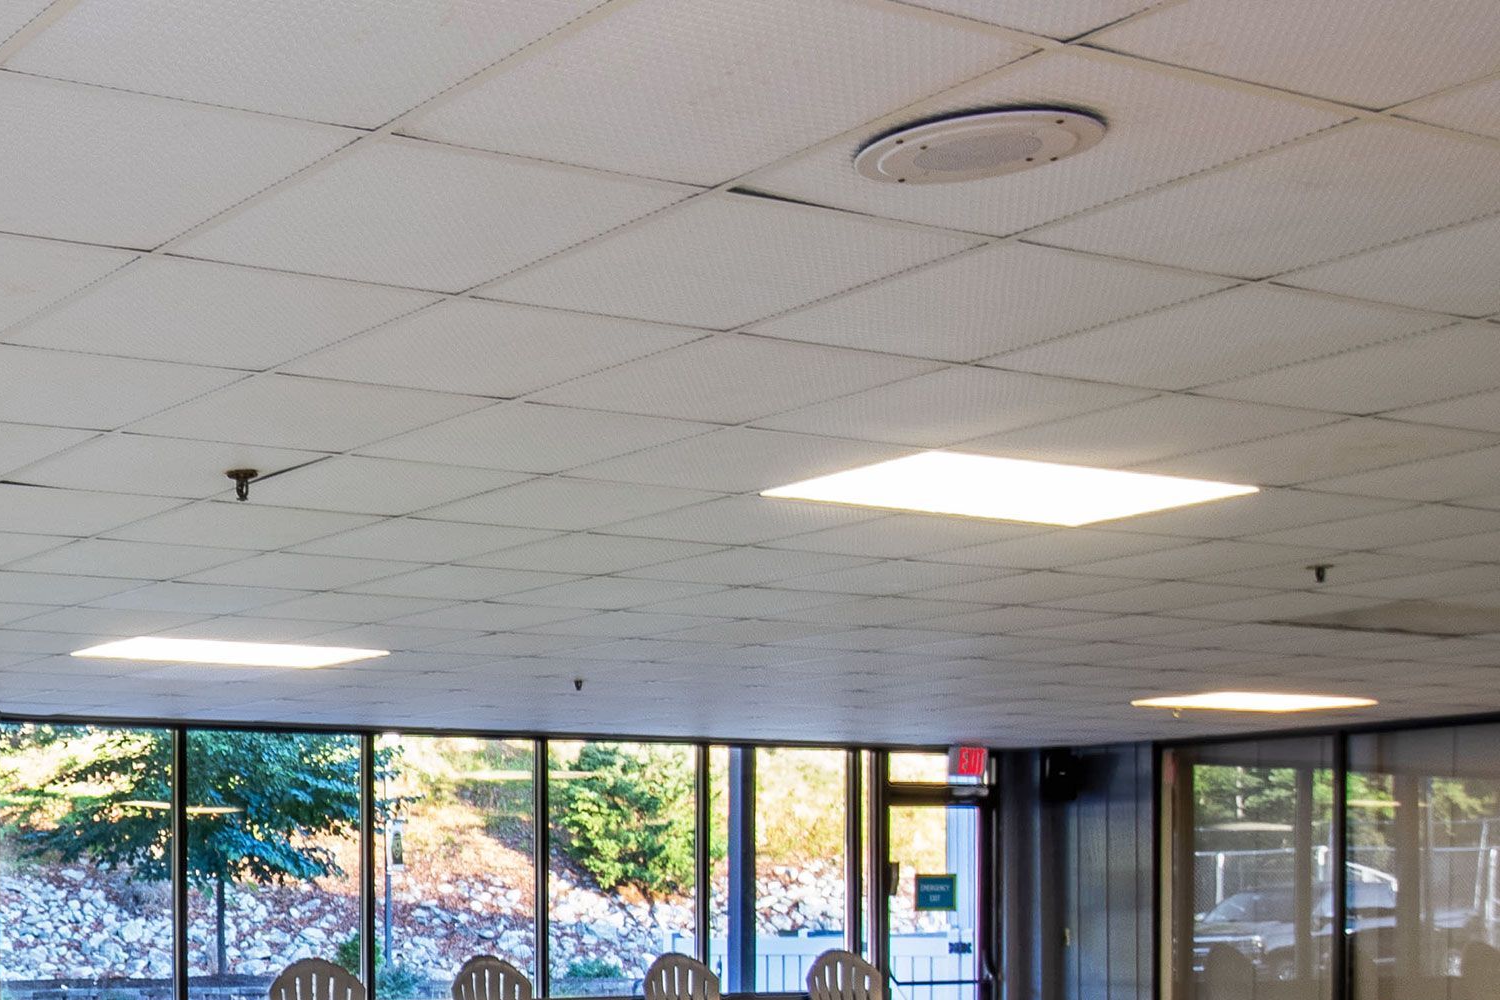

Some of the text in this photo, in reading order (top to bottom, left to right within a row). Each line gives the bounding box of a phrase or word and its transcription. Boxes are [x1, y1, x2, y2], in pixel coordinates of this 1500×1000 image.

[960, 749, 985, 773] EXIT
[920, 884, 950, 892] EMERGENCY
[929, 894, 941, 902] EXIT
